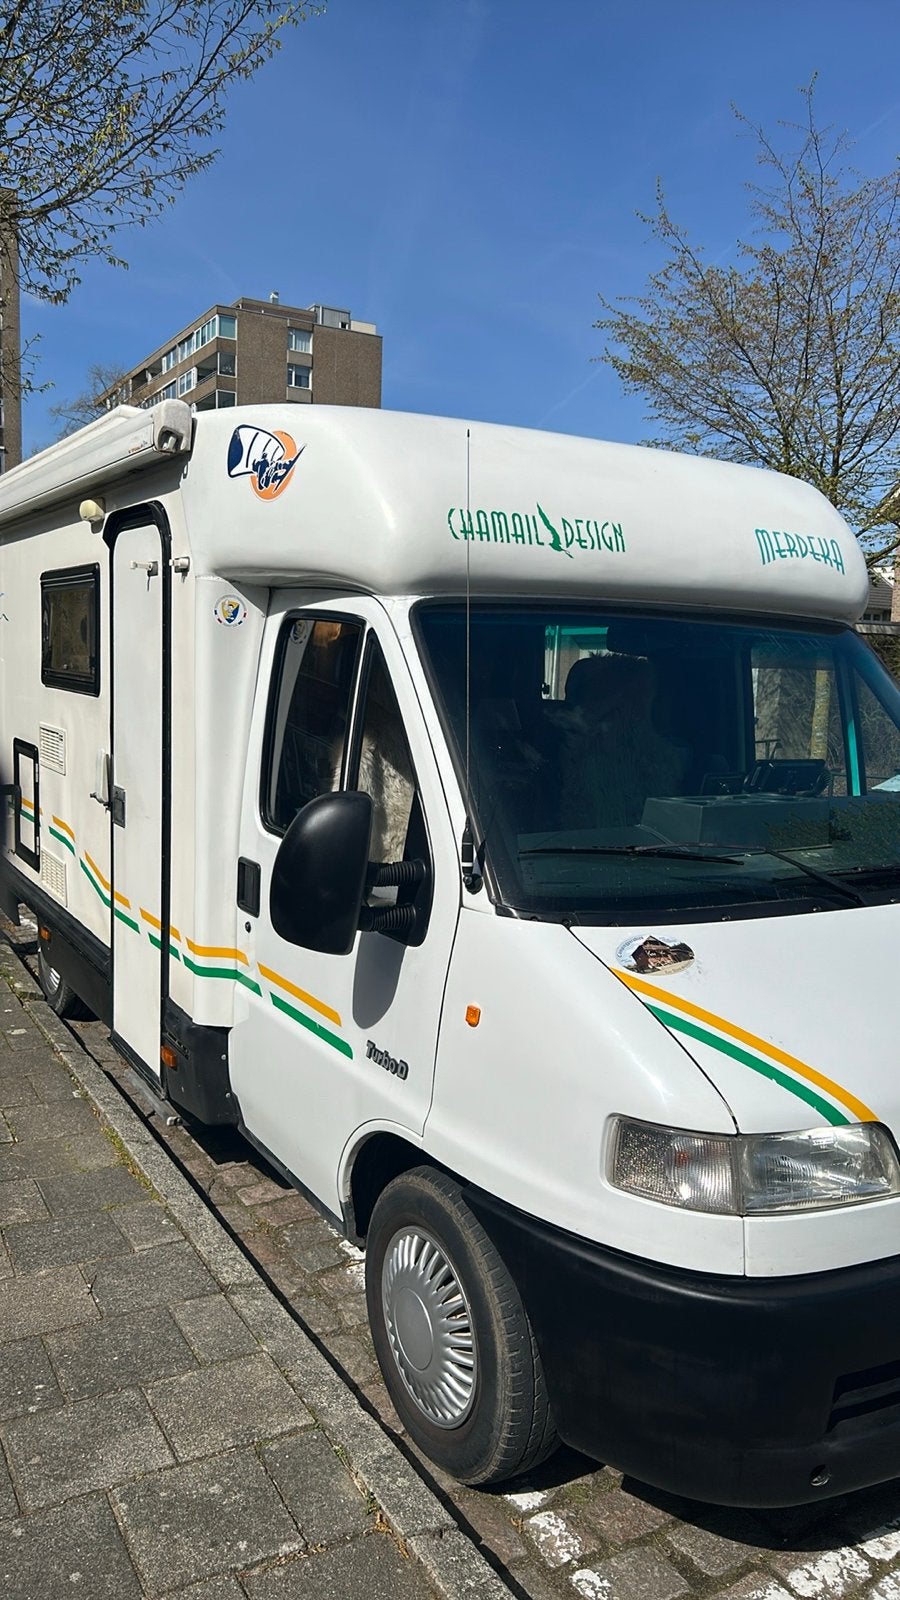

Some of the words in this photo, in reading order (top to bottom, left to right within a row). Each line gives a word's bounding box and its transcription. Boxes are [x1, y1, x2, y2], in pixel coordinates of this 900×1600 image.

[448, 508, 544, 546] CHAMAIL
[561, 517, 625, 553] DESIGN
[755, 528, 845, 576] MERDEKA
